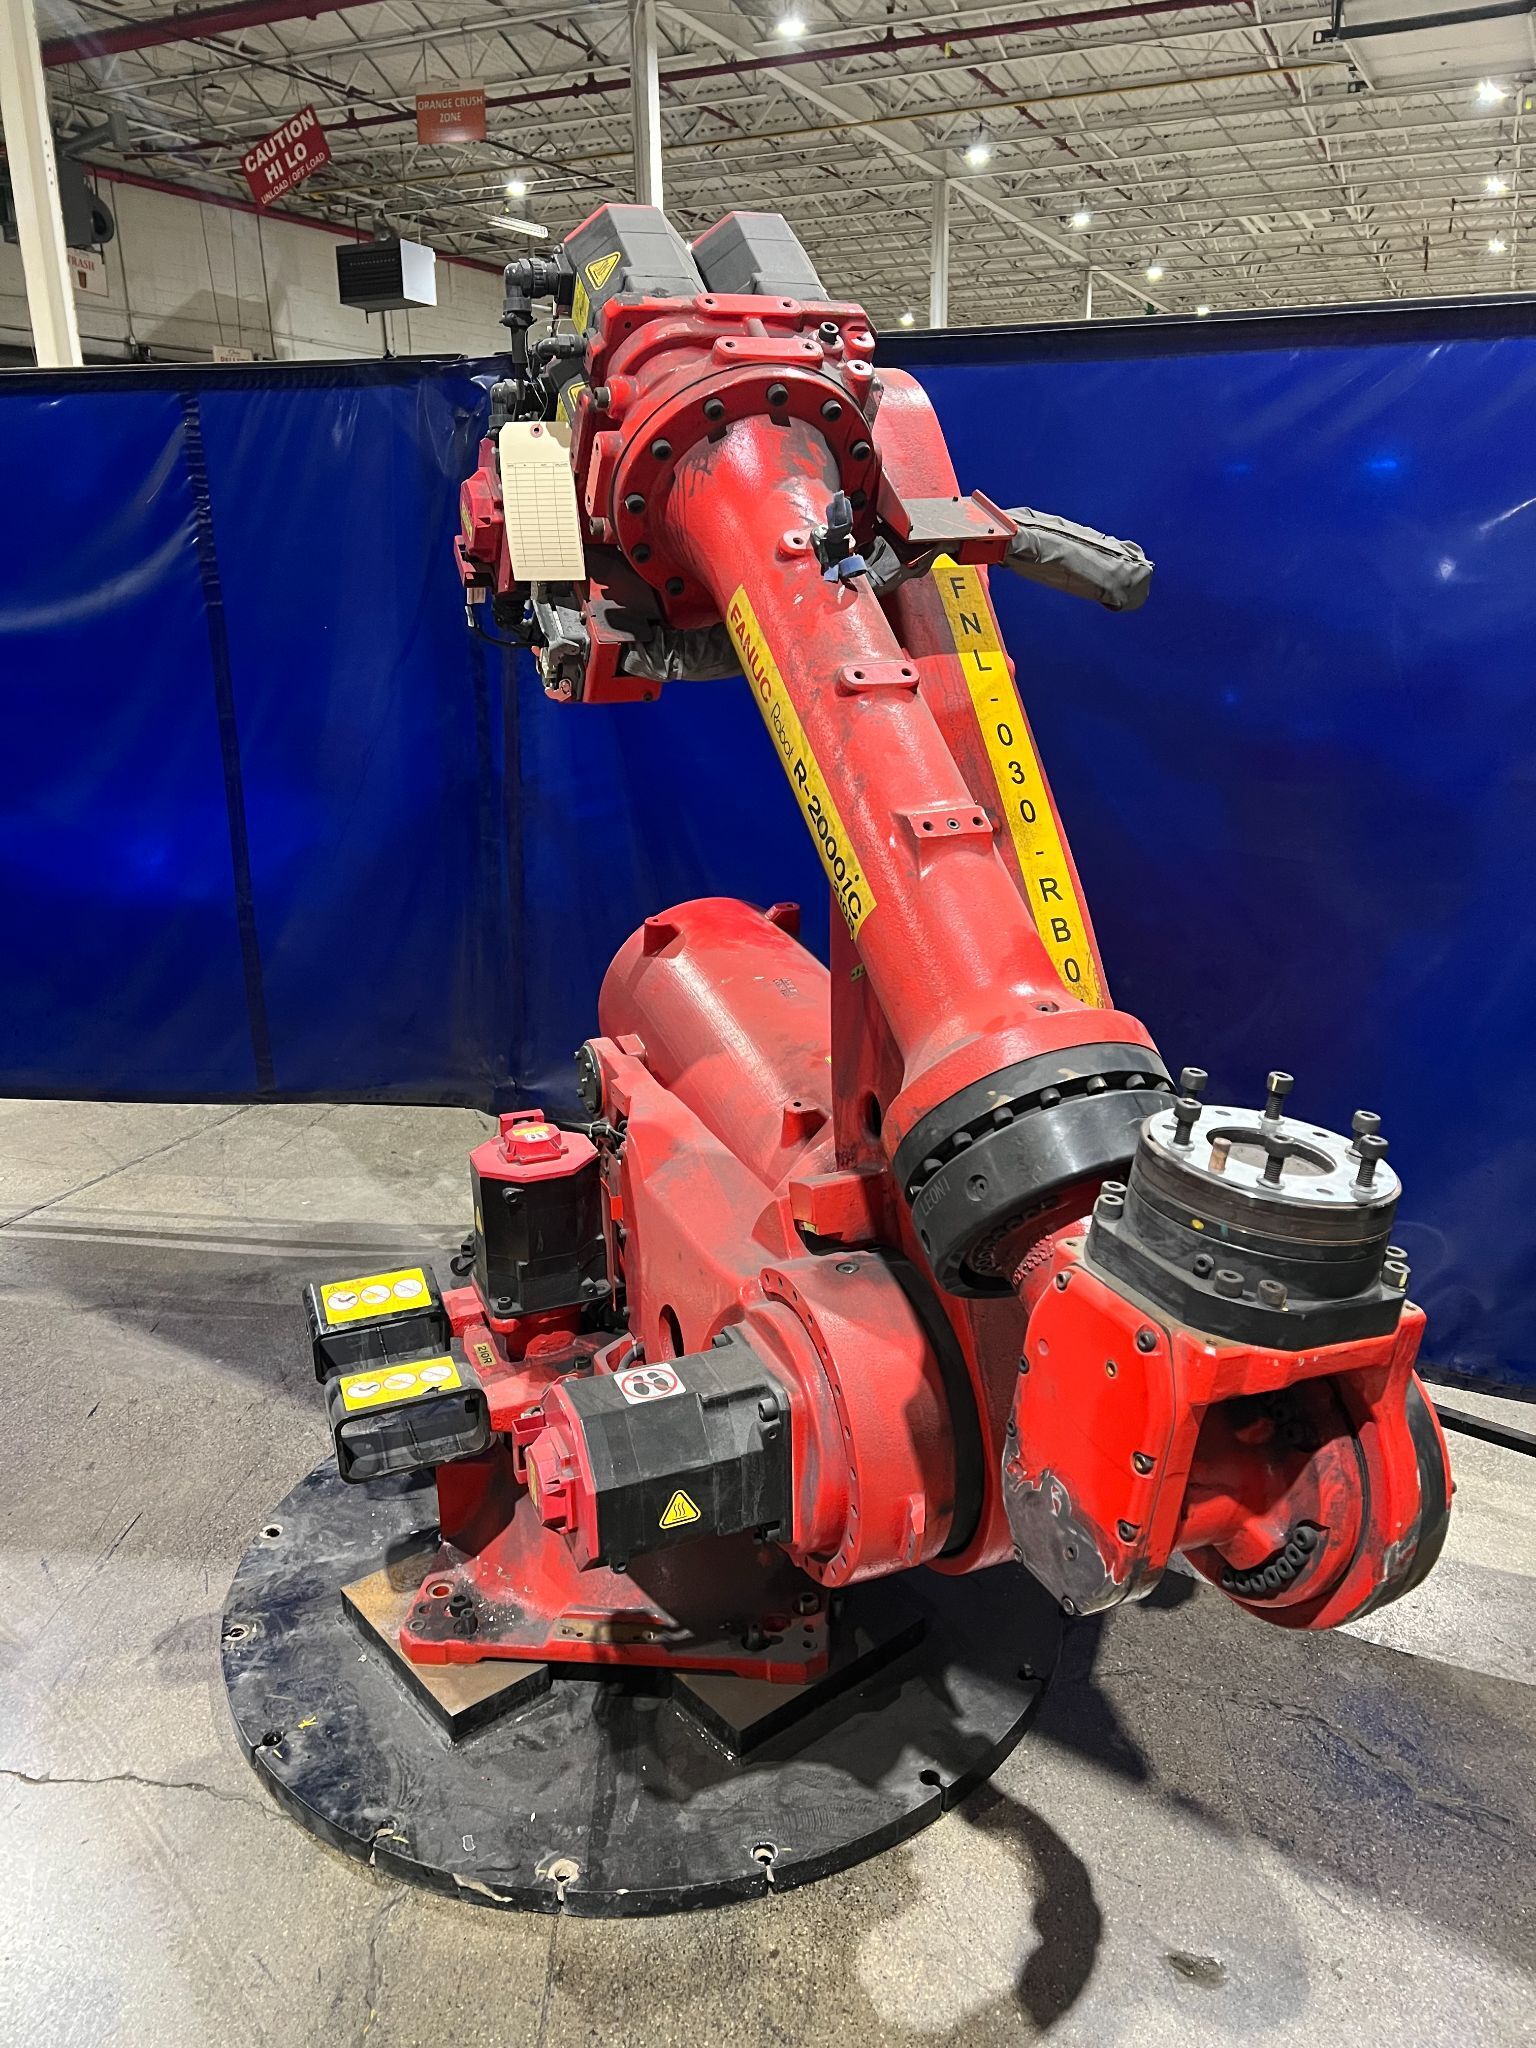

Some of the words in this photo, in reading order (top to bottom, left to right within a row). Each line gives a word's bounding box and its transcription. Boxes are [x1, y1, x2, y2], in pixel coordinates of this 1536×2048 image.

[417, 98, 453, 111] ORANGE
[454, 96, 483, 108] CRUSH
[439, 112, 462, 123] ZONE
[244, 109, 315, 172] CAUTION
[264, 158, 284, 184] HI
[284, 142, 307, 169] LO
[260, 179, 289, 205] UNLOAD
[291, 165, 305, 181] OFF
[305, 152, 326, 171] LOAD
[730, 603, 772, 704] FANUC
[770, 702, 794, 760] Robot
[793, 757, 862, 920] R-2000iC
[949, 577, 1084, 1003] FNL-030-RB0
[477, 1345, 493, 1364] 210R
